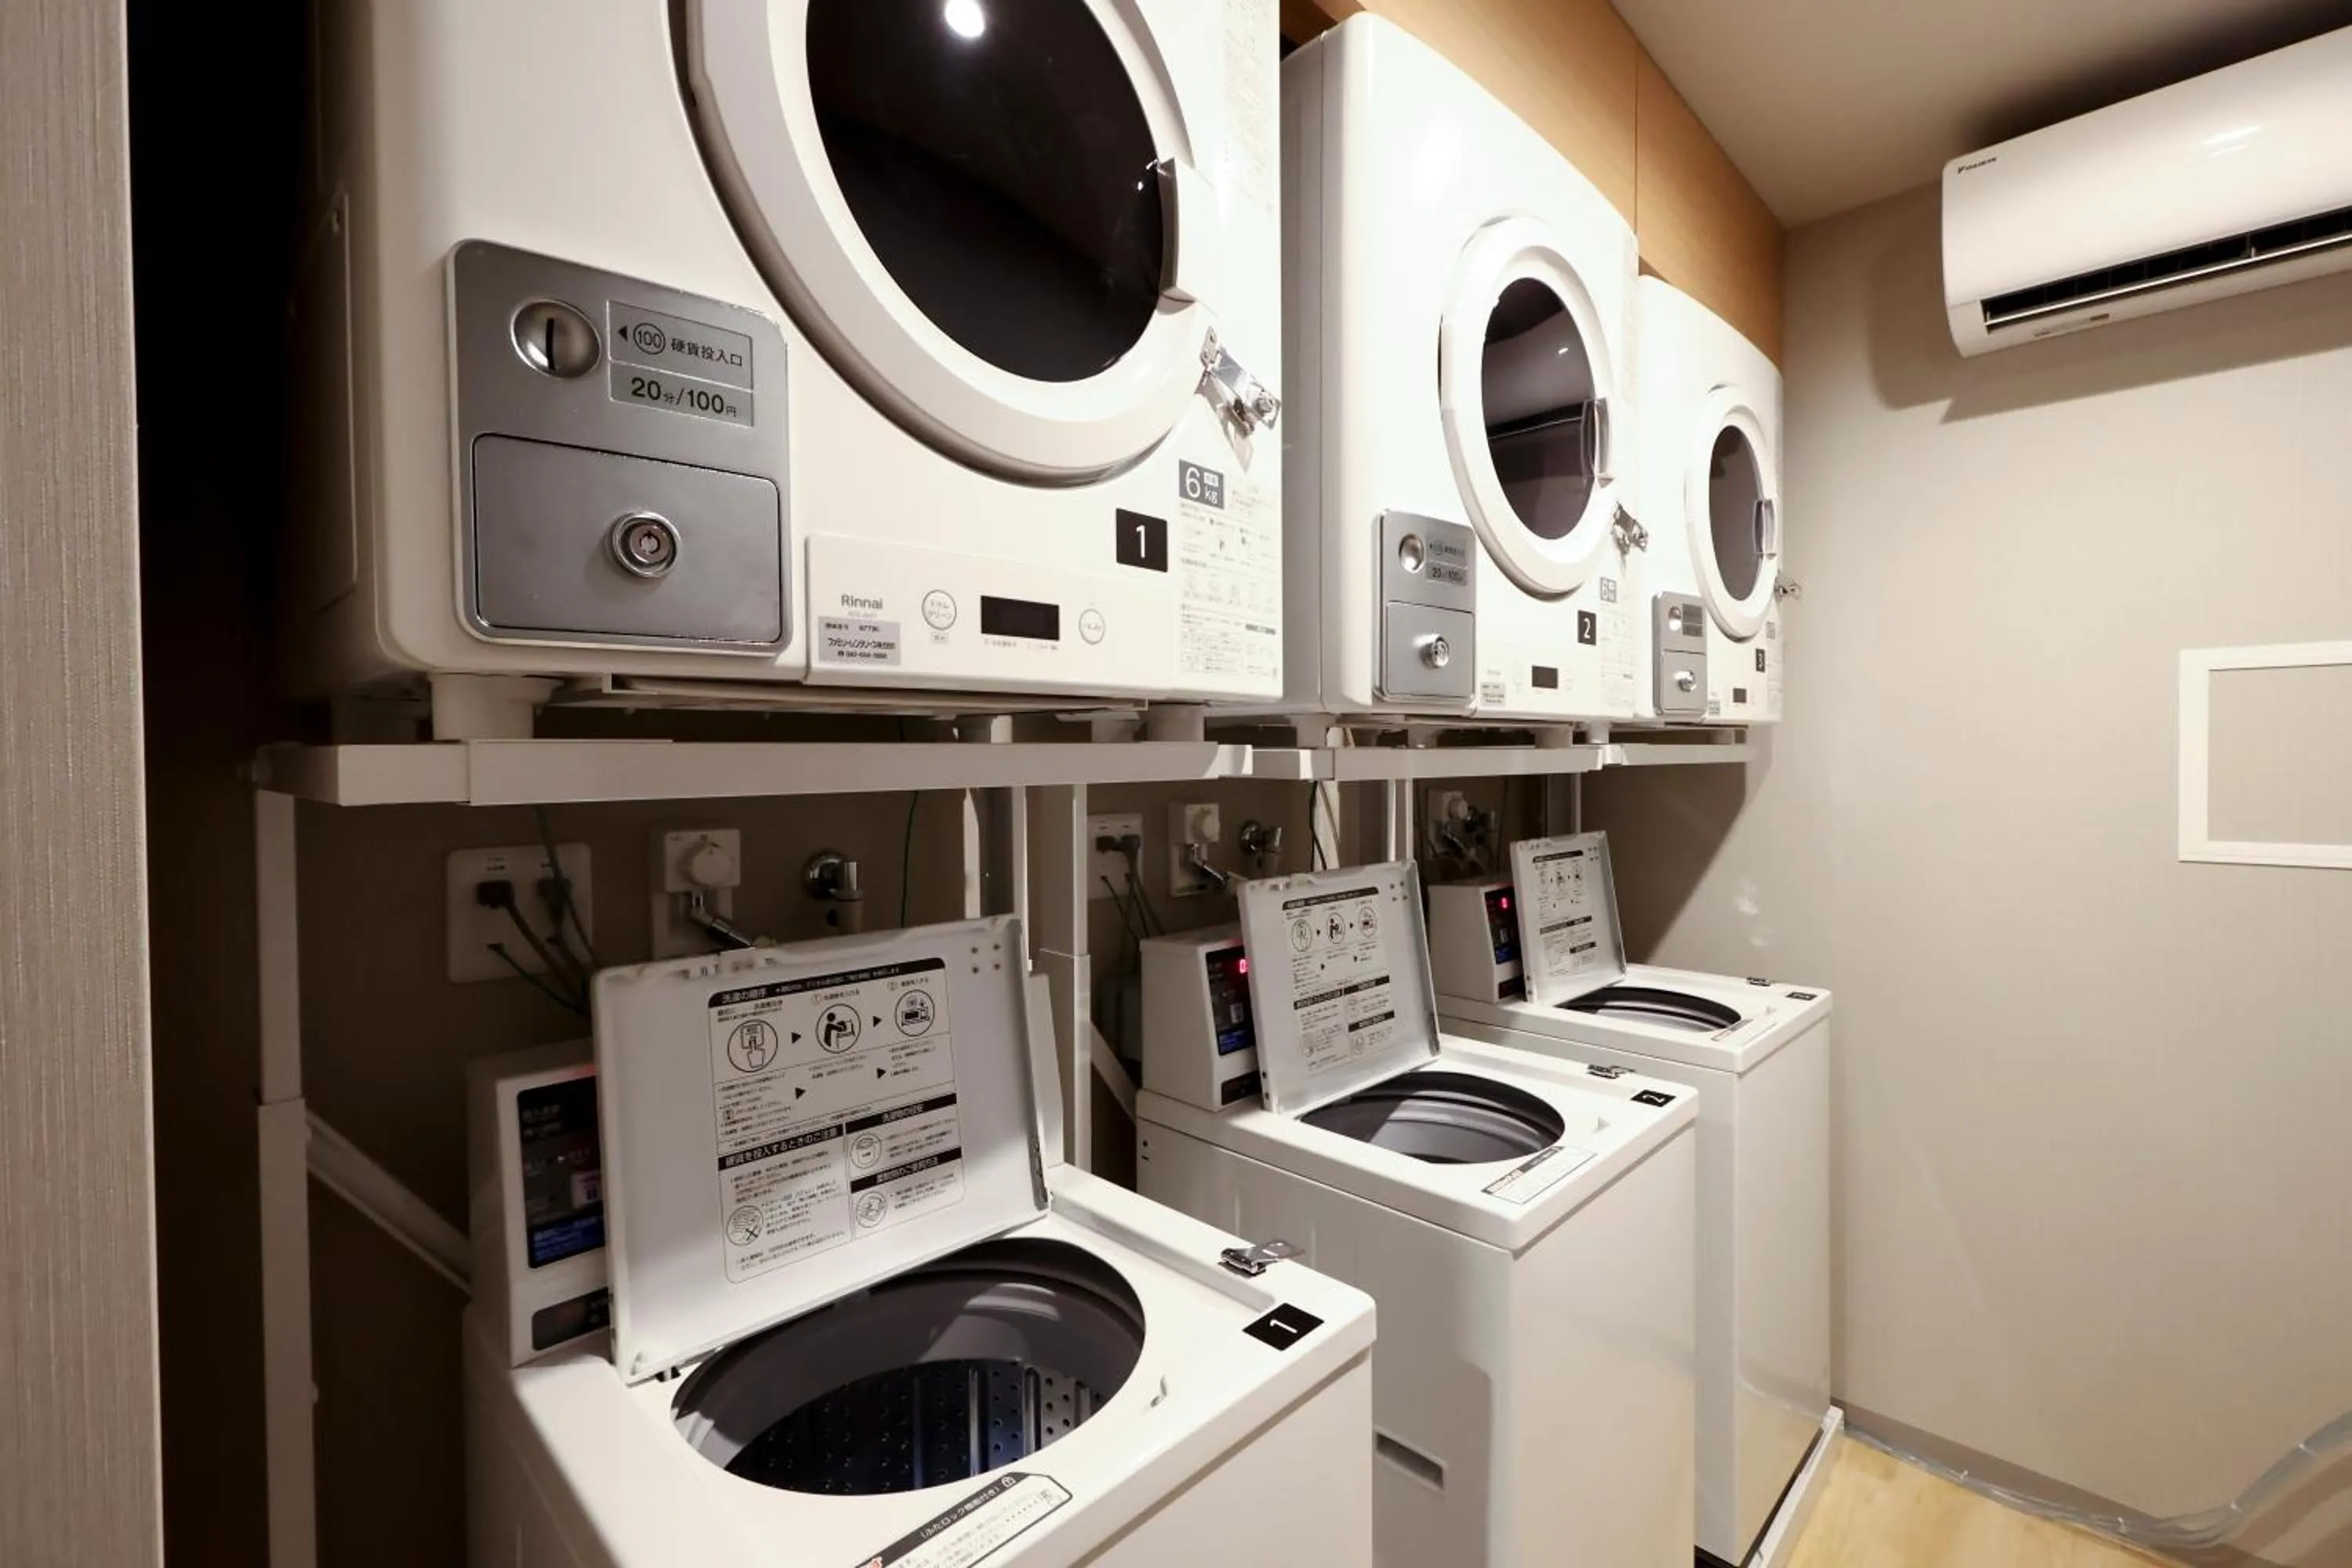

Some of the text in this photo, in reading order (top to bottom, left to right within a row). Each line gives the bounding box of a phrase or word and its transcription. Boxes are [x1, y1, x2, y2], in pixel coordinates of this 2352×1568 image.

[635, 328, 742, 367] 100 硬貨投入口
[1185, 466, 1201, 499] 6
[1136, 524, 1146, 559] 1
[841, 593, 884, 609] Rinnai
[1584, 617, 1591, 639] 2
[1269, 1319, 1298, 1334] 1
